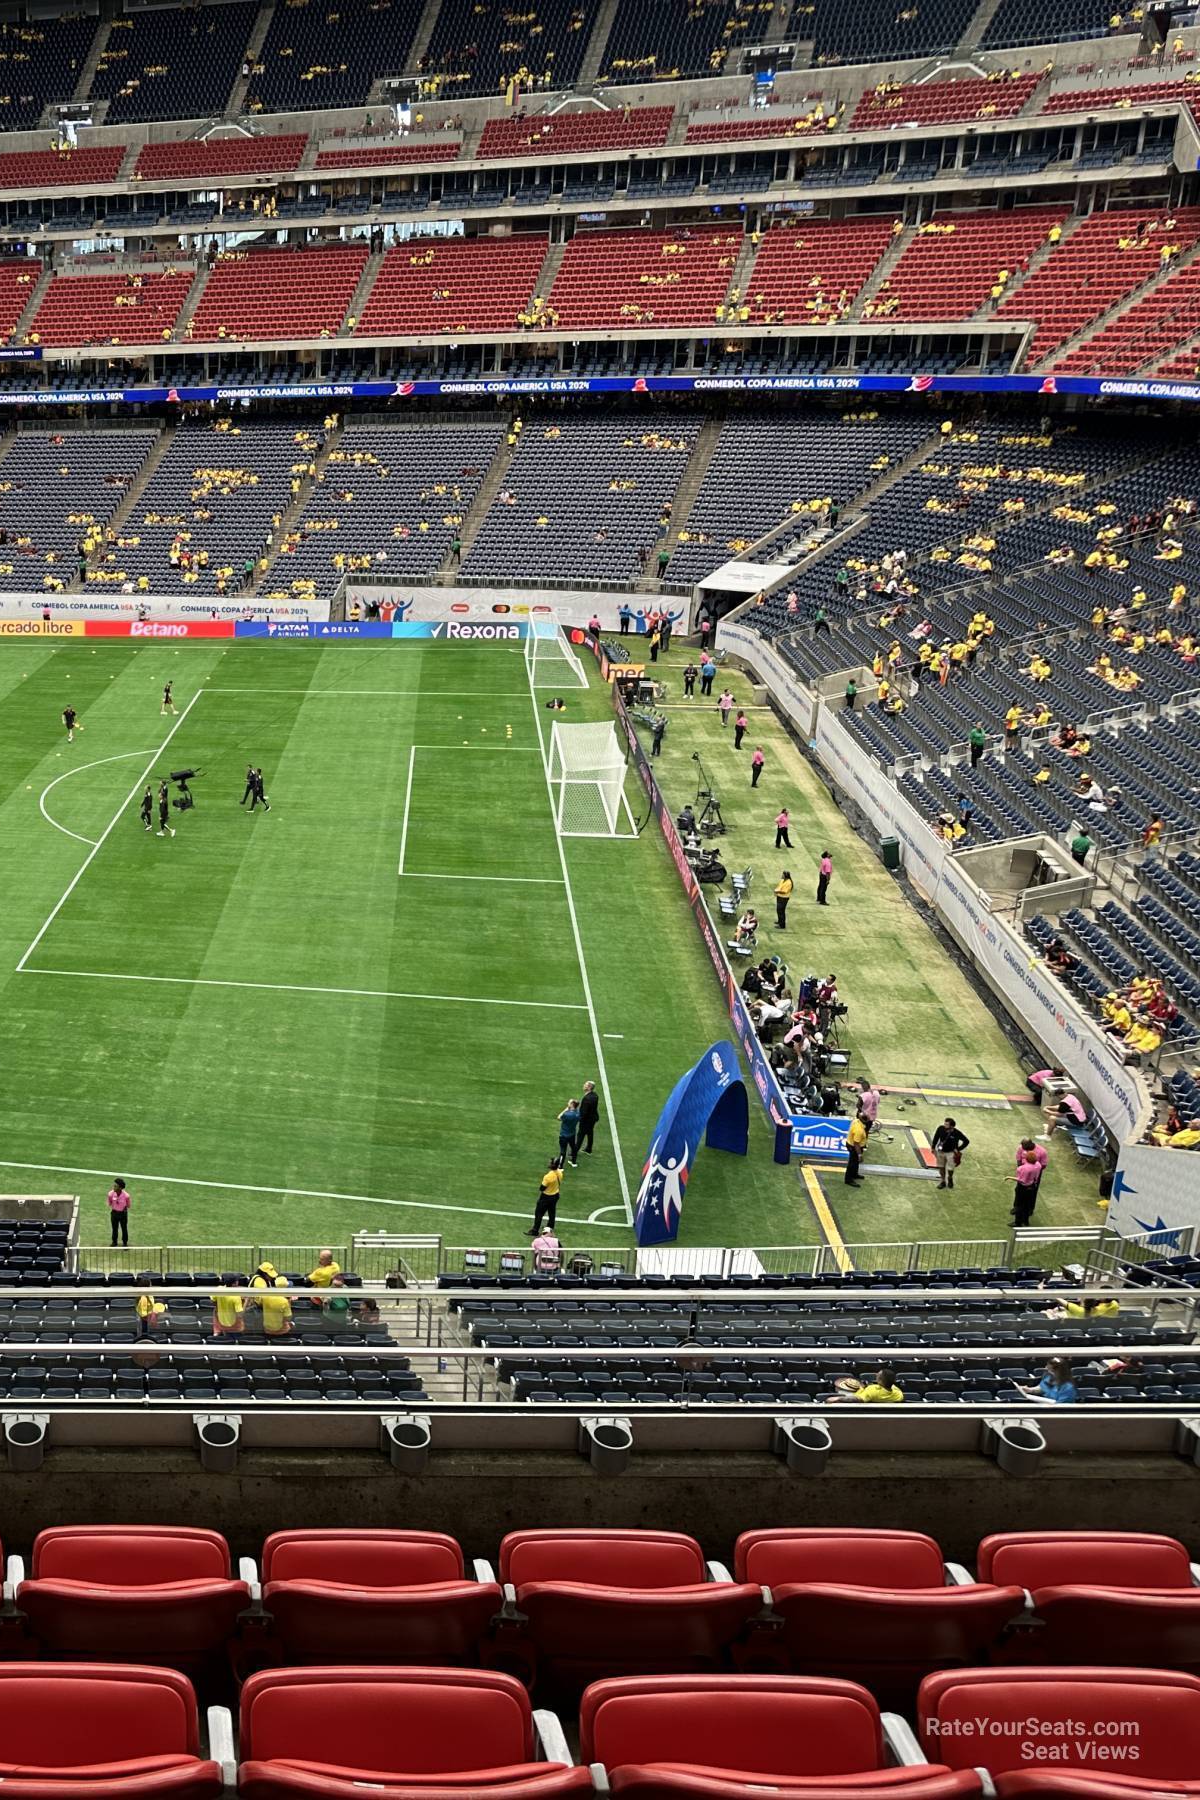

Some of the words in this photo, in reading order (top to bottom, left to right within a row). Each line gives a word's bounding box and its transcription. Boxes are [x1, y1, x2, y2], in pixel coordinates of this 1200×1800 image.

[440, 383, 486, 392] CONMEBOL
[488, 383, 510, 392] COPA
[510, 382, 548, 391] AMERICA
[550, 382, 567, 391] USA
[569, 381, 590, 390] 2024
[694, 379, 746, 388] CONMEBOL
[747, 379, 772, 388] COPA
[773, 379, 814, 388] AMERICA
[817, 379, 835, 388] USA
[836, 379, 860, 388] 2024
[1100, 382, 1150, 395] CONMEBOL
[1150, 385, 1170, 396] COPA
[38, 394, 58, 402] COPA
[58, 393, 90, 402] AMERICA
[92, 393, 105, 401] USA
[106, 392, 124, 401] 2024
[217, 388, 259, 398] CONMEBOL
[260, 388, 281, 397] COPA
[282, 387, 316, 396] AMERICA
[318, 387, 332, 395] USA
[334, 386, 353, 395] 2024
[43, 621, 73, 633] libre
[130, 622, 188, 636] Betano
[447, 622, 520, 638] Rexona
[1003, 949, 1026, 981] CONMEBOL
[1025, 976, 1038, 995] COPA
[1036, 990, 1056, 1017] AMERICA
[1056, 1012, 1065, 1030] USA
[1065, 1022, 1077, 1041] 2024
[1088, 1049, 1114, 1090] CONMEBOL
[1114, 1084, 1128, 1105] COPA
[793, 1132, 847, 1150] LOWE'S
